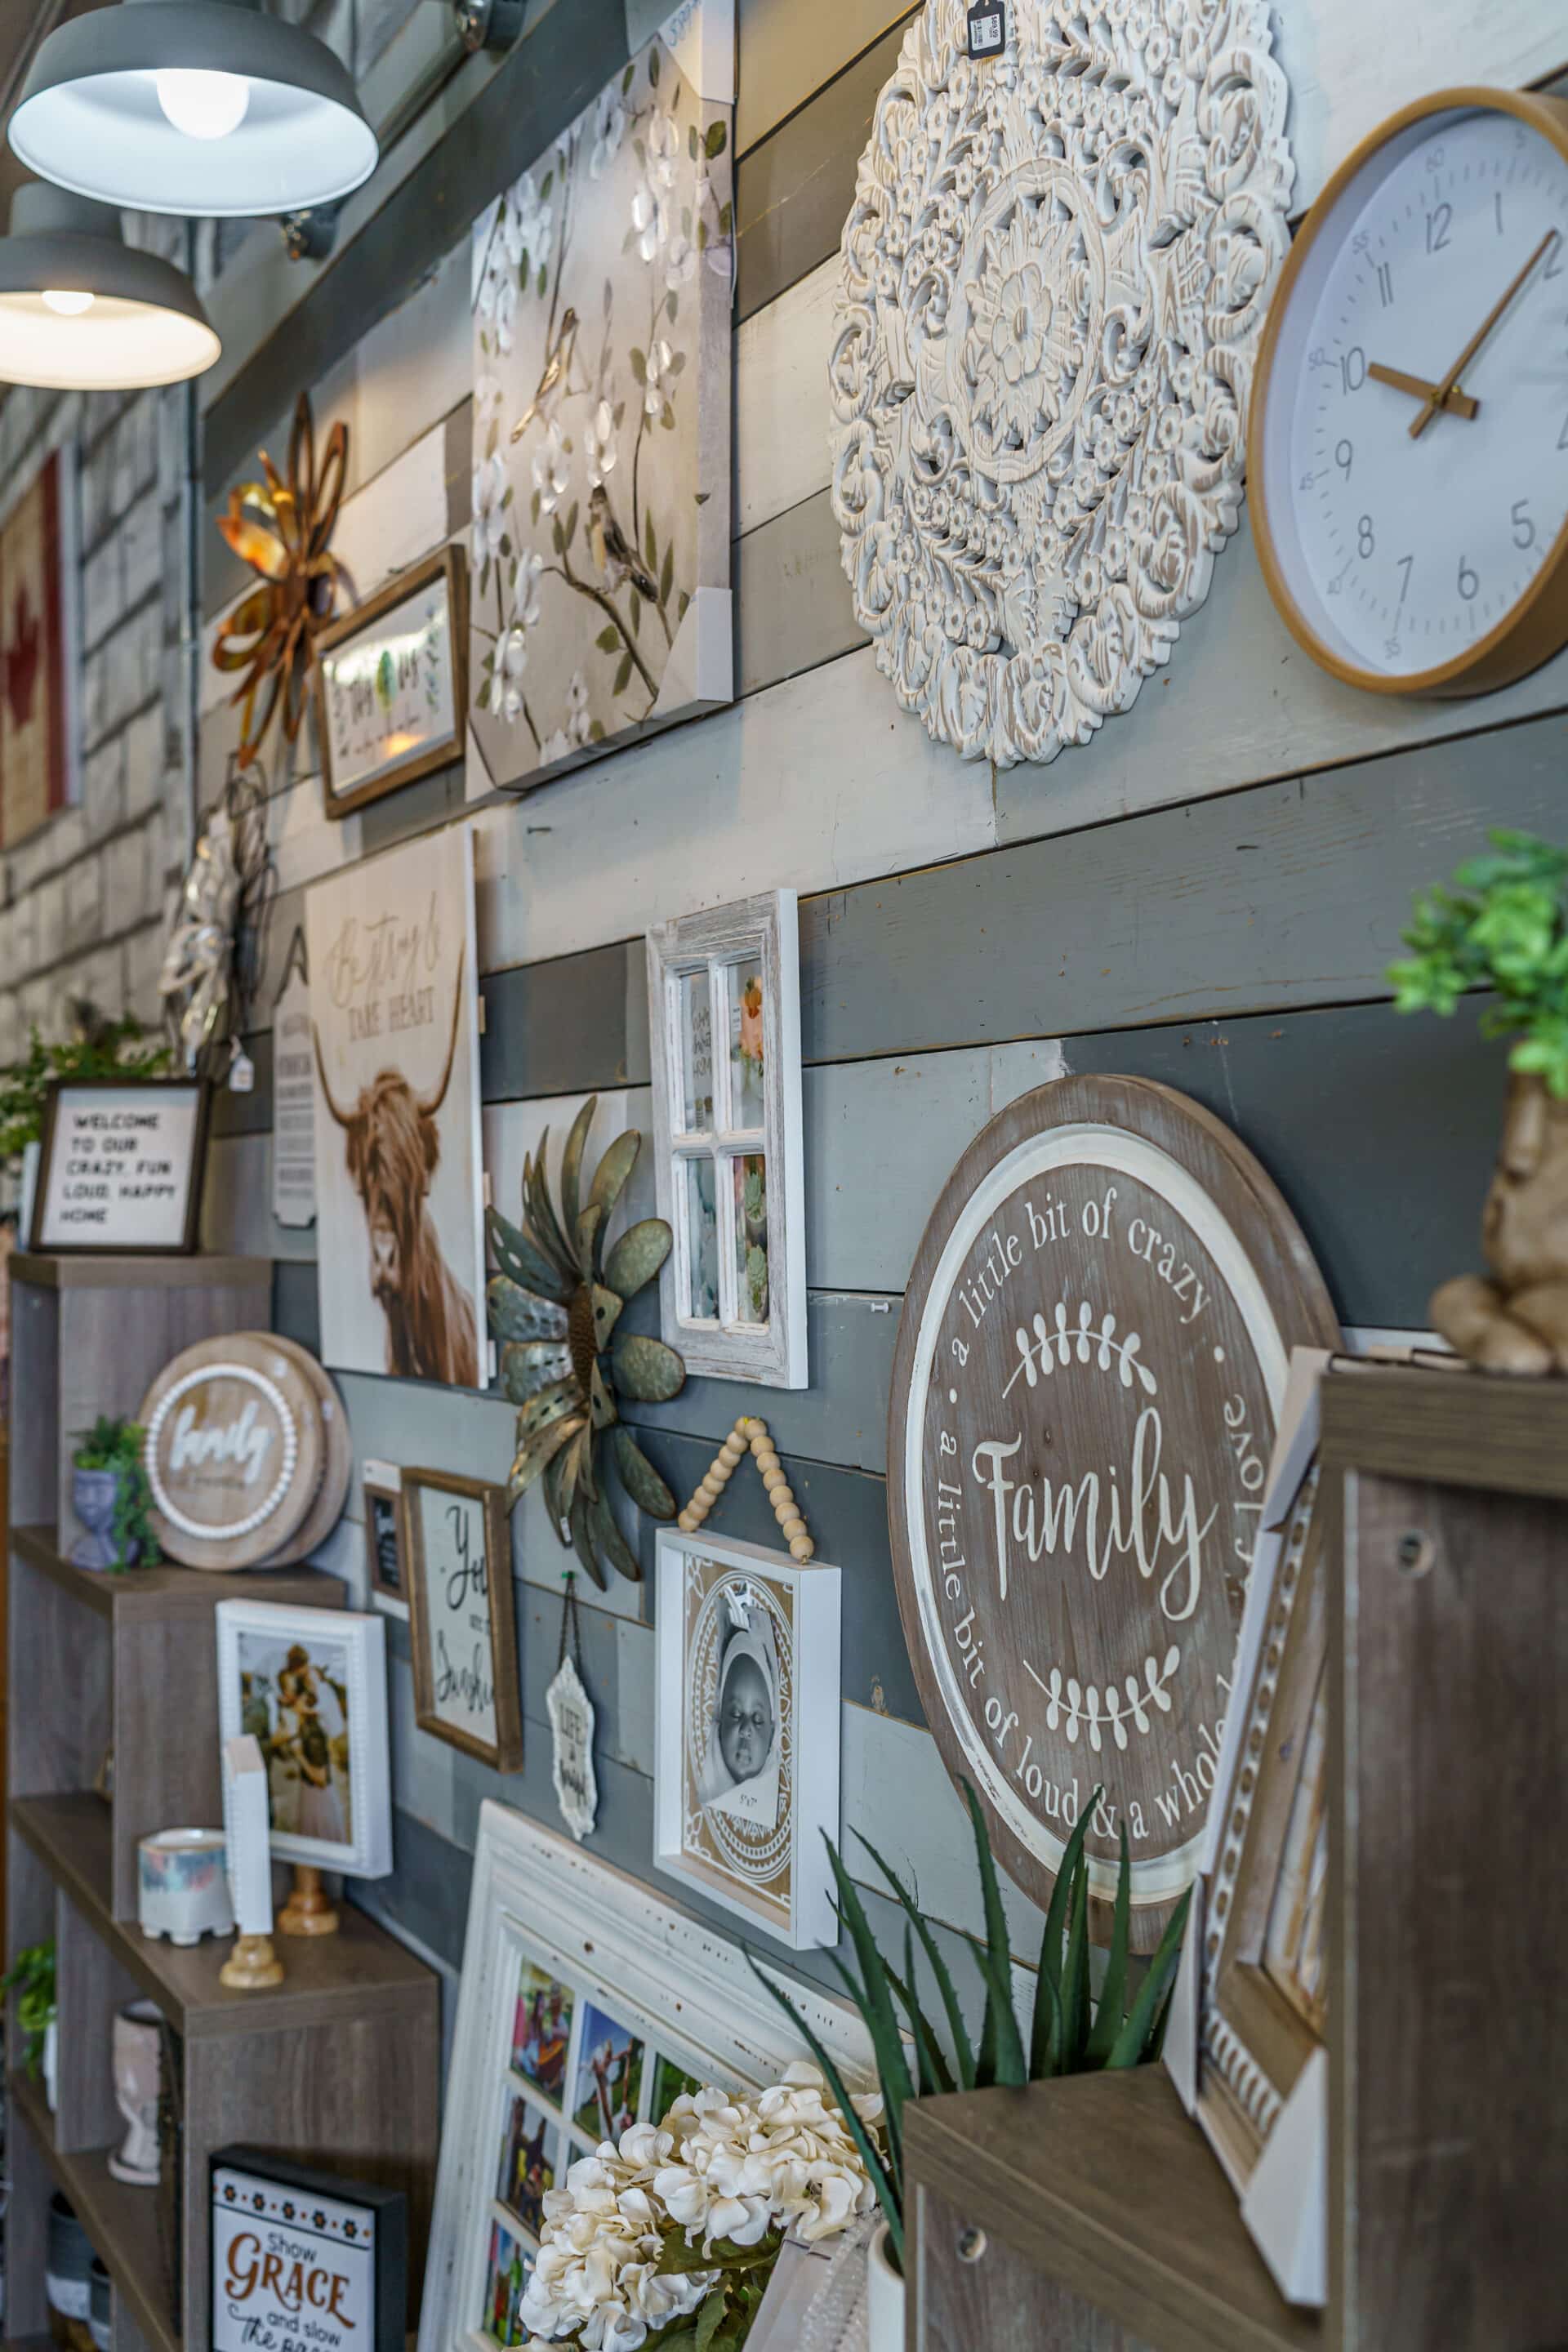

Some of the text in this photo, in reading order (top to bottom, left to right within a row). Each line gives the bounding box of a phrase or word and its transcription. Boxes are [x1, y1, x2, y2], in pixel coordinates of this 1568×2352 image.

[1427, 203, 1453, 254] 12
[1494, 192, 1503, 235] 1
[1542, 224, 1564, 279] 2
[1378, 261, 1394, 307] 11
[1340, 346, 1365, 395] 10
[1334, 439, 1352, 482] 9
[1357, 514, 1374, 559] 8
[1511, 499, 1535, 550] 5
[1396, 556, 1414, 603] 7
[1458, 555, 1479, 600] 6
[74, 1113, 158, 1129] WELCOME
[72, 1138, 137, 1152] TO OUR
[64, 1184, 174, 1199] LOUD HAPPY
[60, 1208, 106, 1223] HOME
[951, 1187, 1211, 1367] a little bit of crazy
[939, 1431, 957, 1456] a
[972, 1406, 1219, 1621] Family
[938, 1480, 966, 1601] little
[953, 1606, 985, 1690] bit
[985, 1697, 1018, 1748] of
[1016, 1736, 1079, 1829] loud
[1090, 1784, 1120, 1841] &
[1130, 1801, 1149, 1840] a
[225, 2231, 355, 2328] GRACE
[266, 2311, 342, 2347] and slow
